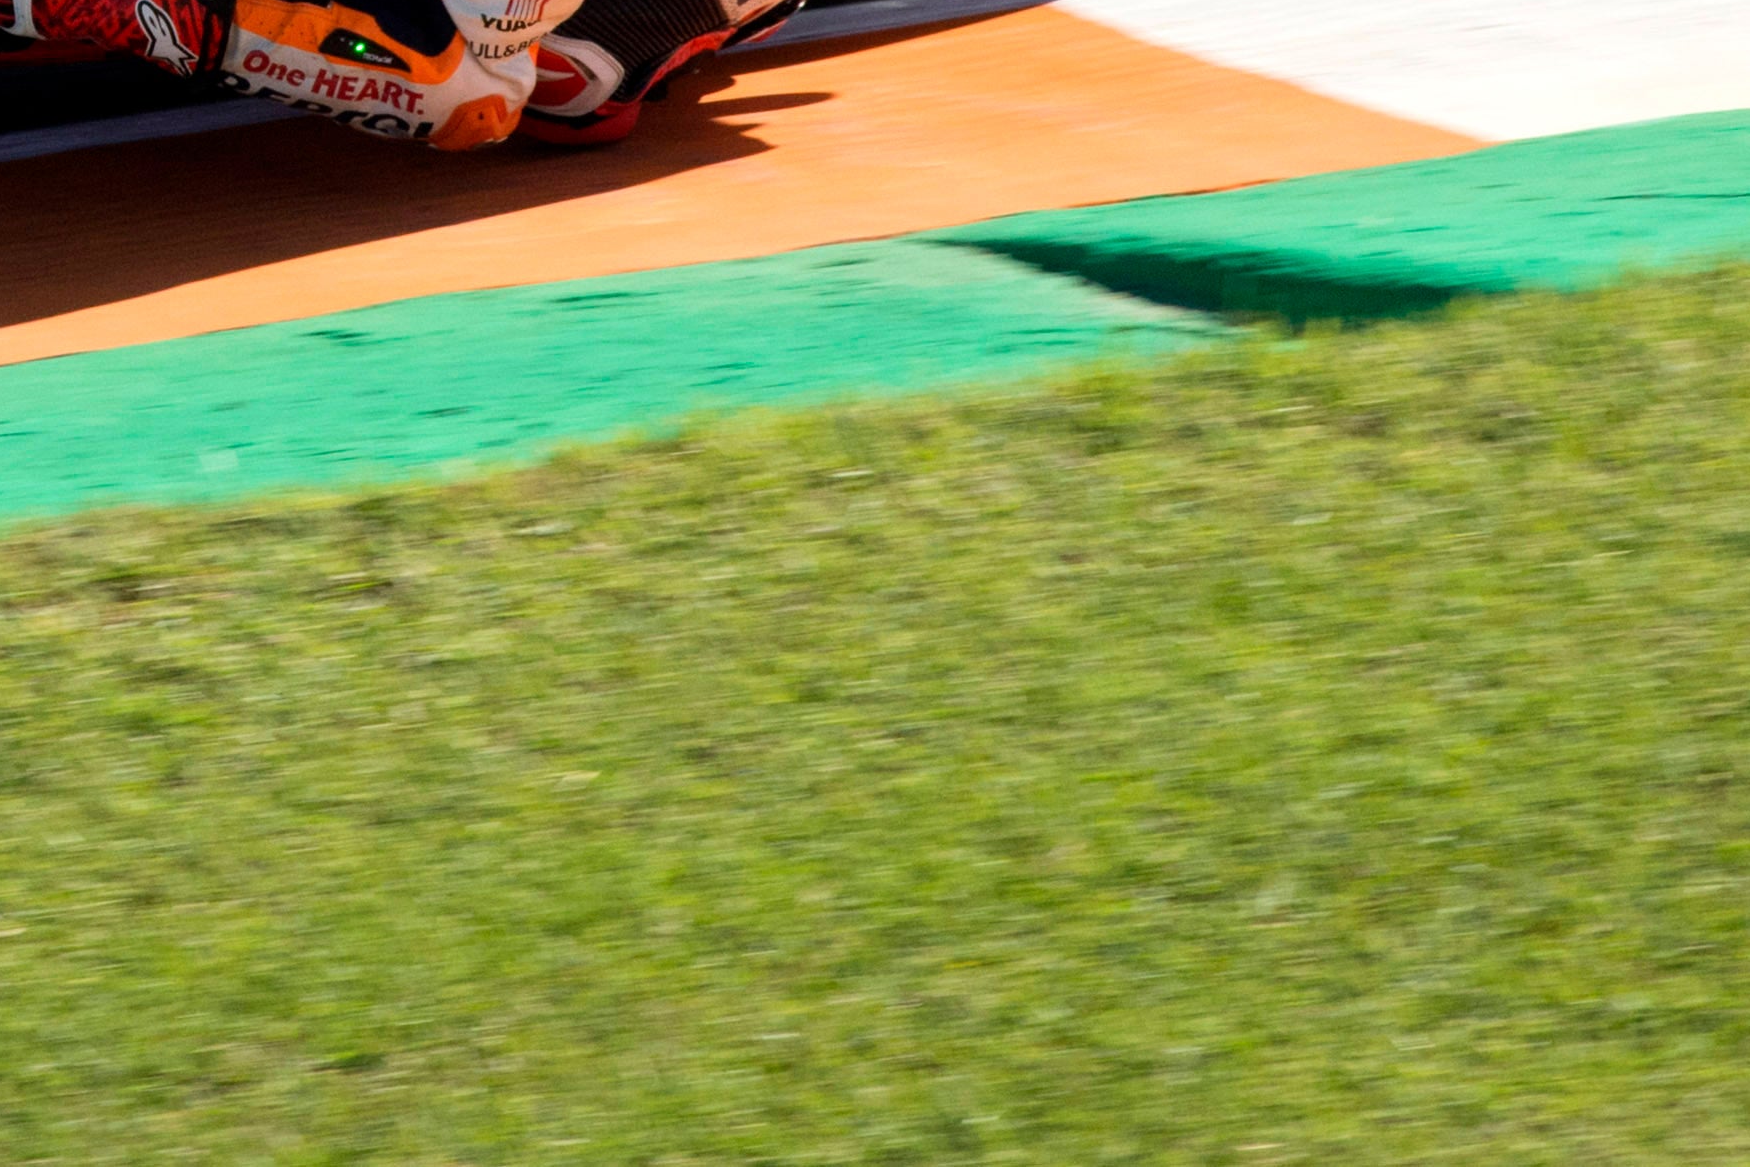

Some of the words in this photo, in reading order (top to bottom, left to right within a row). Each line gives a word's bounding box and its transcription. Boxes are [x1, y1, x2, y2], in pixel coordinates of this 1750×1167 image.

[480, 12, 541, 32] YUA
[243, 49, 305, 86] One
[311, 69, 424, 115] HEART.
